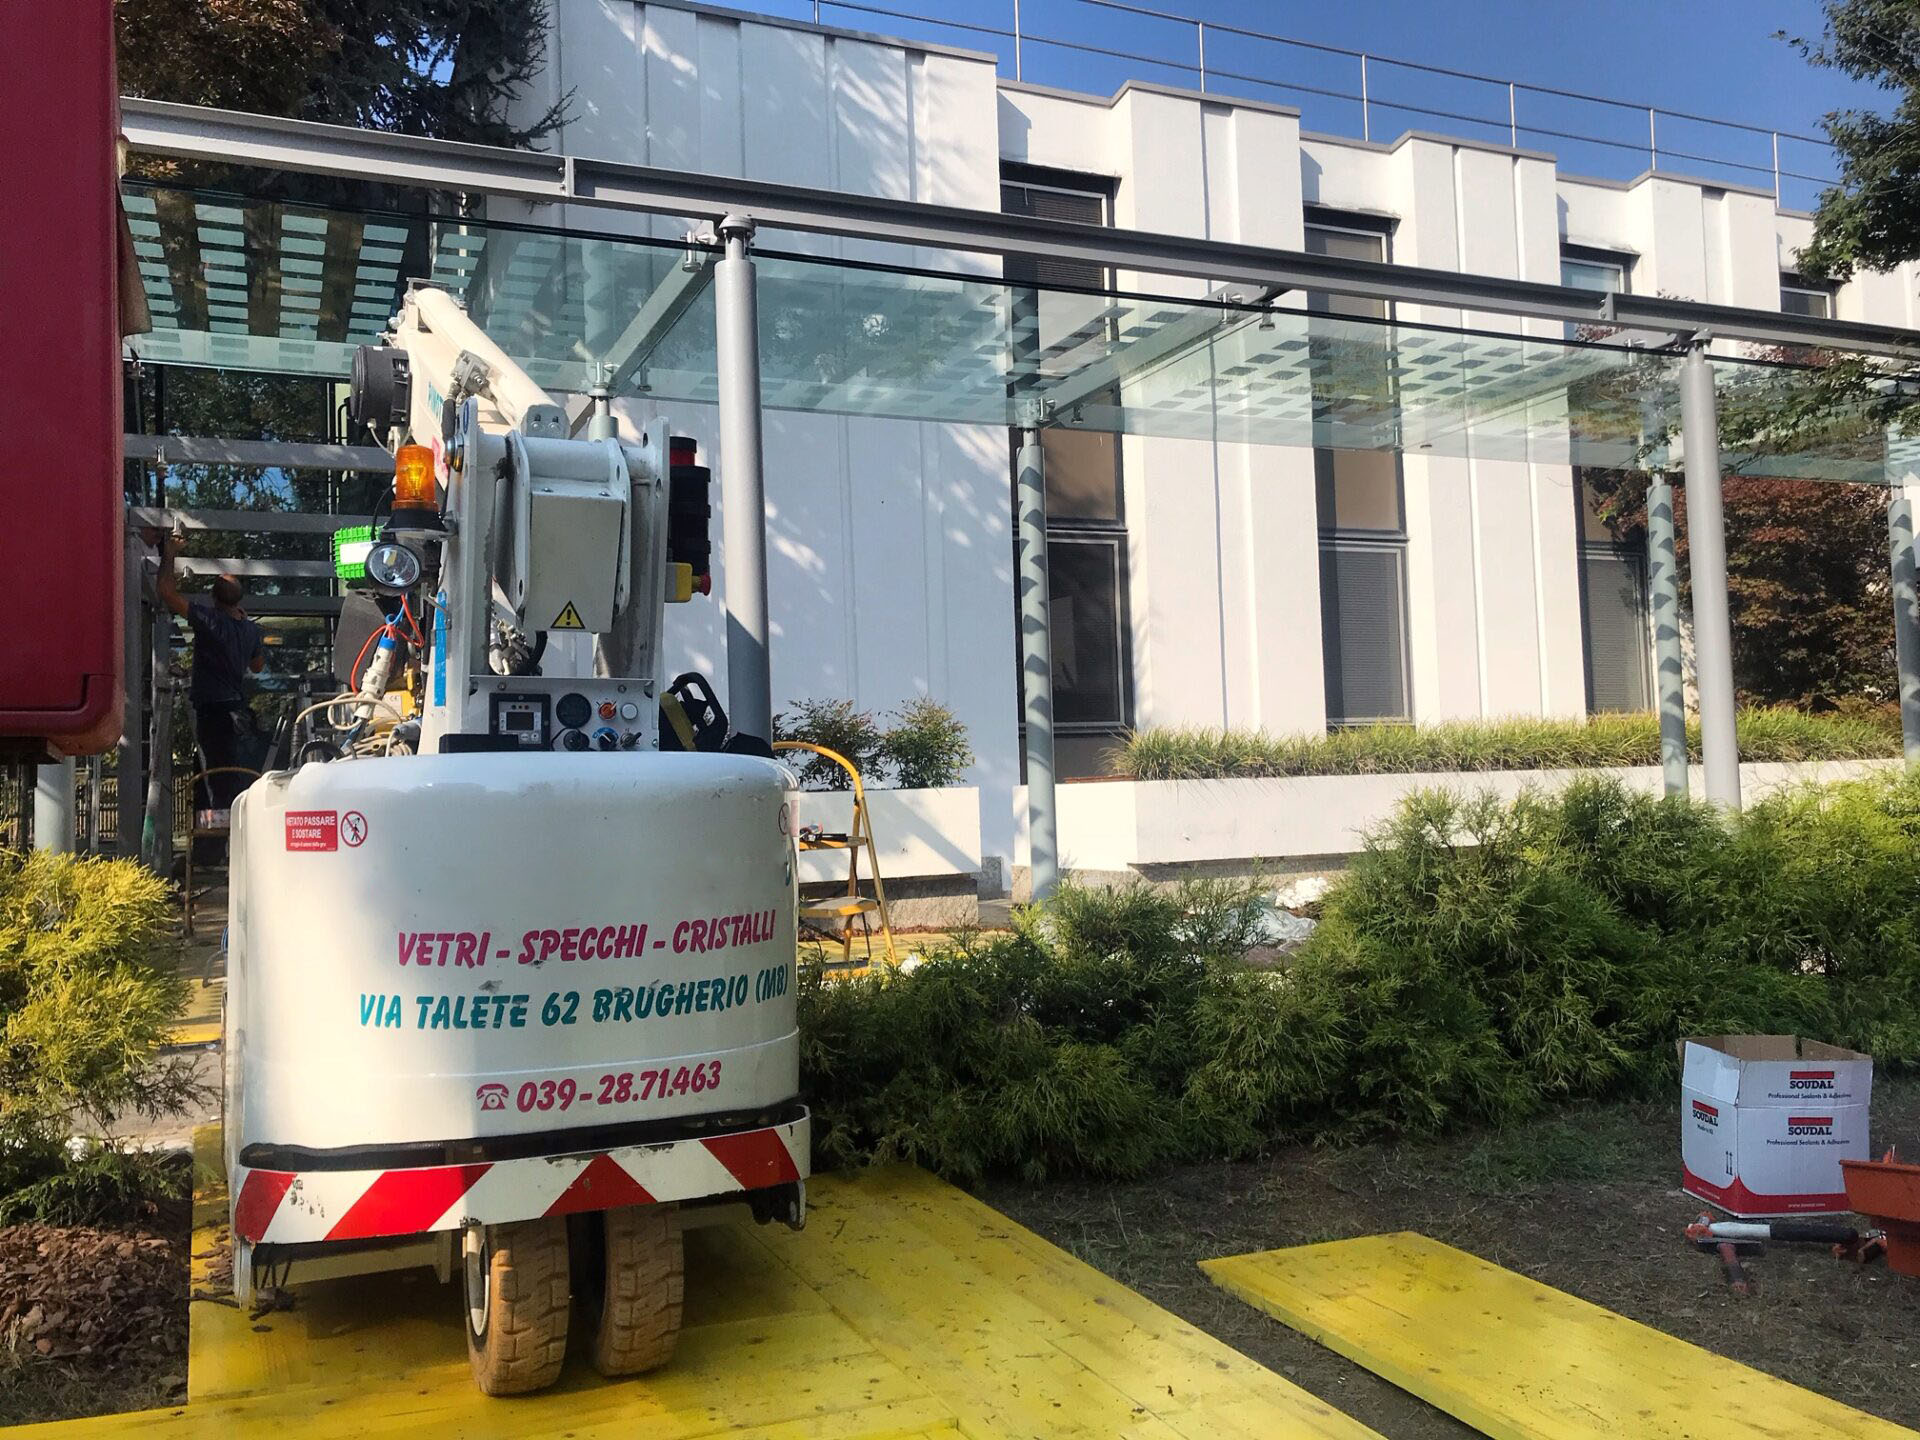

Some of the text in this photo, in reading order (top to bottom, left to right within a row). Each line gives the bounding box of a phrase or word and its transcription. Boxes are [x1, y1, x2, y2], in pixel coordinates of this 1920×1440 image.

[304, 816, 335, 826] PASSARE
[295, 829, 321, 838] SOSTARE
[398, 931, 491, 969] VETRI
[518, 924, 648, 965] SPECCHI
[672, 909, 776, 954] CRISTALLI
[360, 963, 788, 1030] VIA TALETE 62 BRUGHERIO (MB)
[516, 1060, 722, 1113] 039-28.71.463
[1790, 1080, 1834, 1089] SOUDAL
[1692, 1109, 1719, 1127] SOUDAL
[1788, 1126, 1832, 1135] SOUDAL
